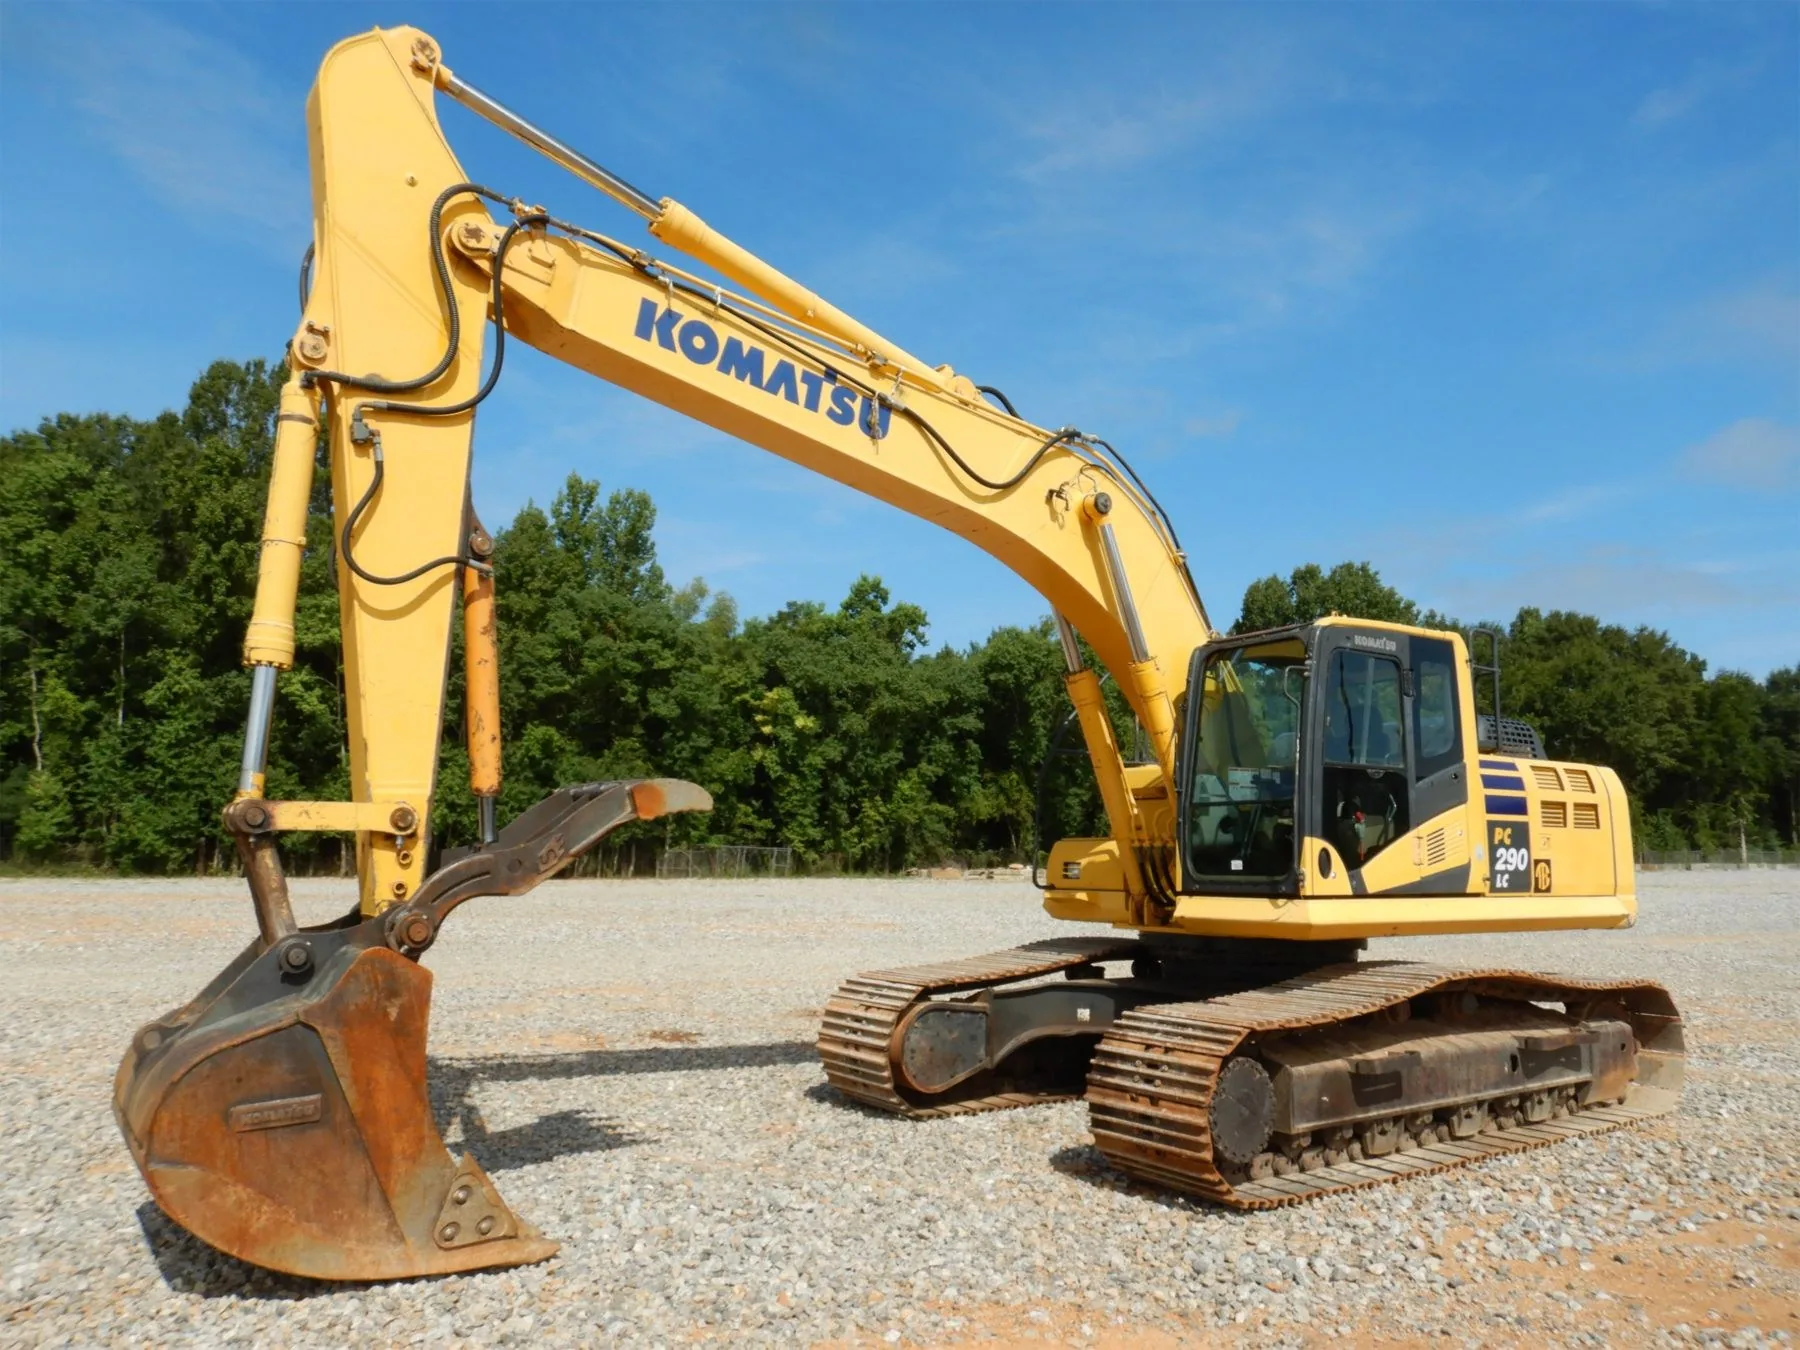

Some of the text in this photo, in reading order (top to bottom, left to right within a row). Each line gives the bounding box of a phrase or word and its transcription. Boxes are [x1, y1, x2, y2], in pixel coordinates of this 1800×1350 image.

[634, 297, 892, 440] KOMATSU
[1354, 634, 1397, 651] KOMATSU
[1493, 827, 1512, 845] PC
[1494, 847, 1528, 871] 290
[1495, 873, 1510, 888] LC
